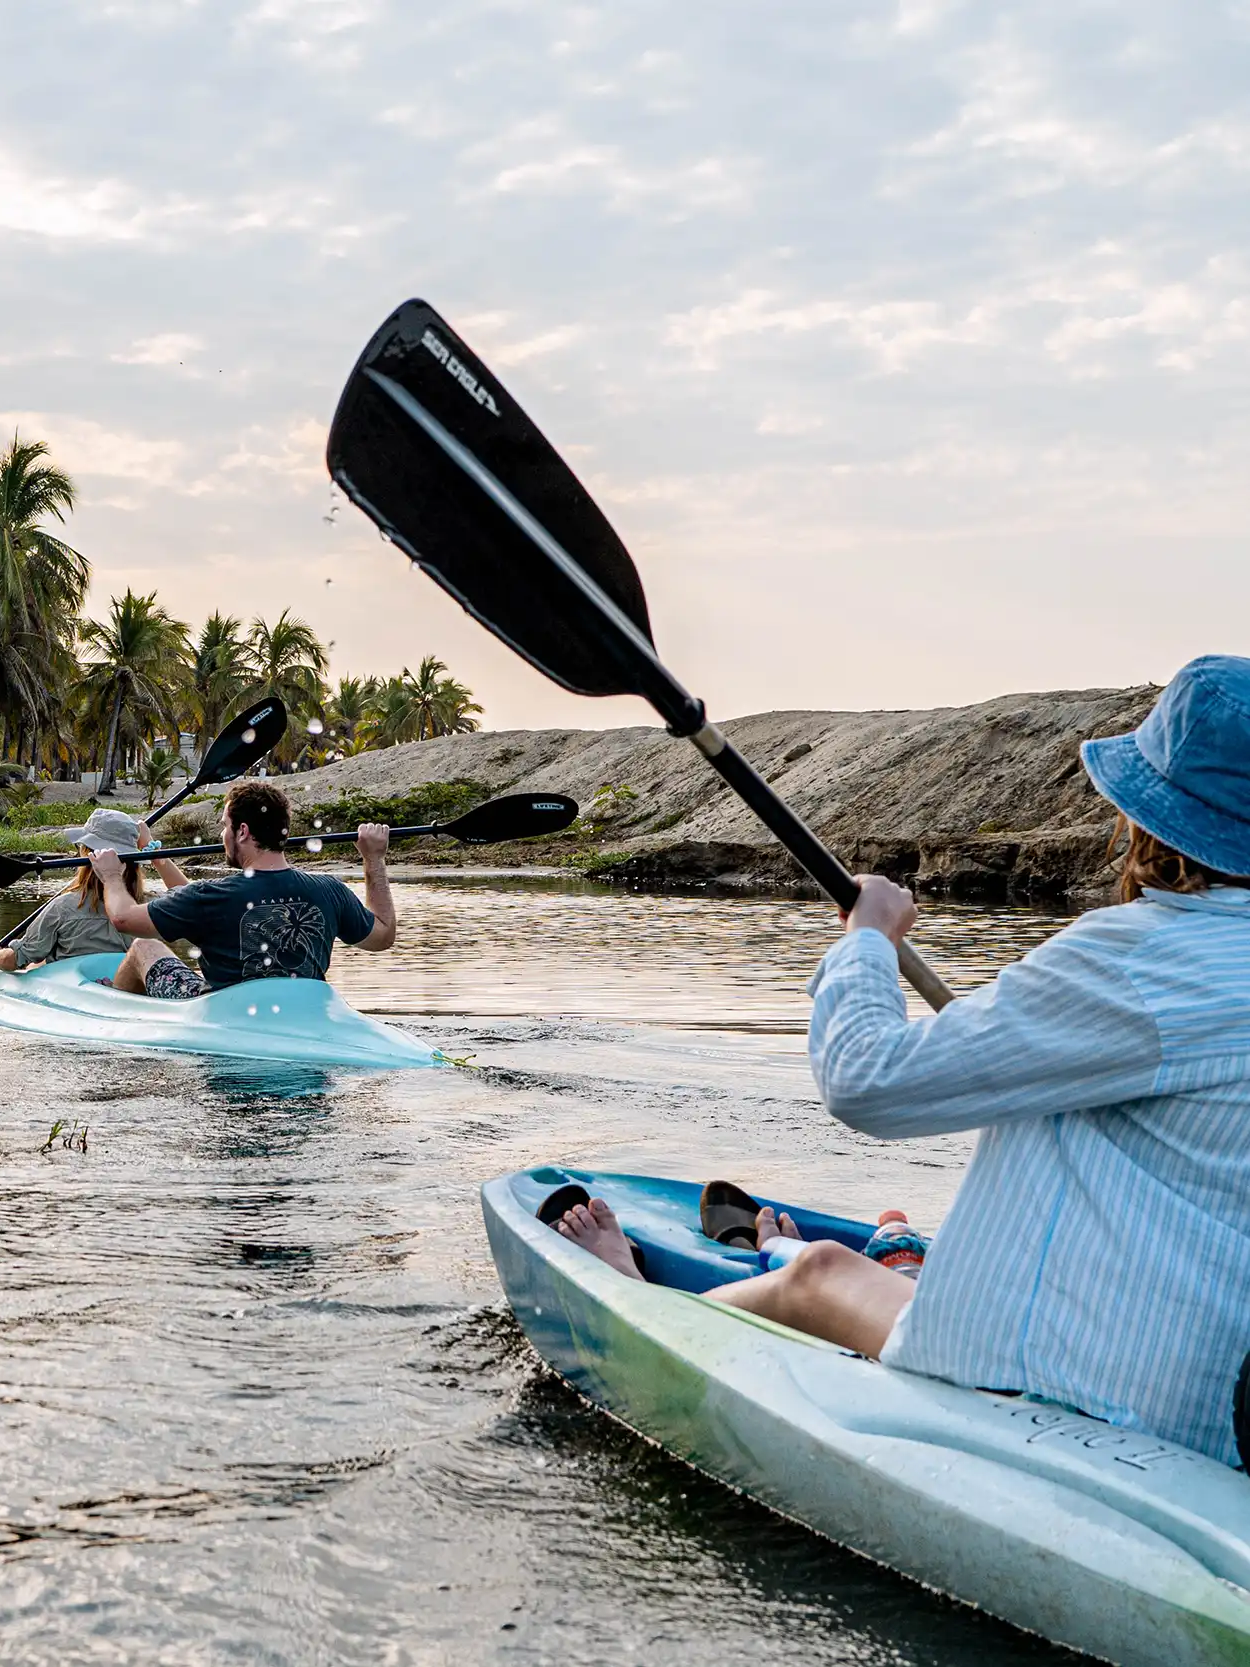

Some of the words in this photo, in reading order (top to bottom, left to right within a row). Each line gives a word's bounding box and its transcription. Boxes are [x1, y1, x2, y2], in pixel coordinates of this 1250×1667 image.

[421, 330, 450, 365] SEA
[446, 355, 487, 405] EAGLE
[261, 896, 301, 905] KAUAI
